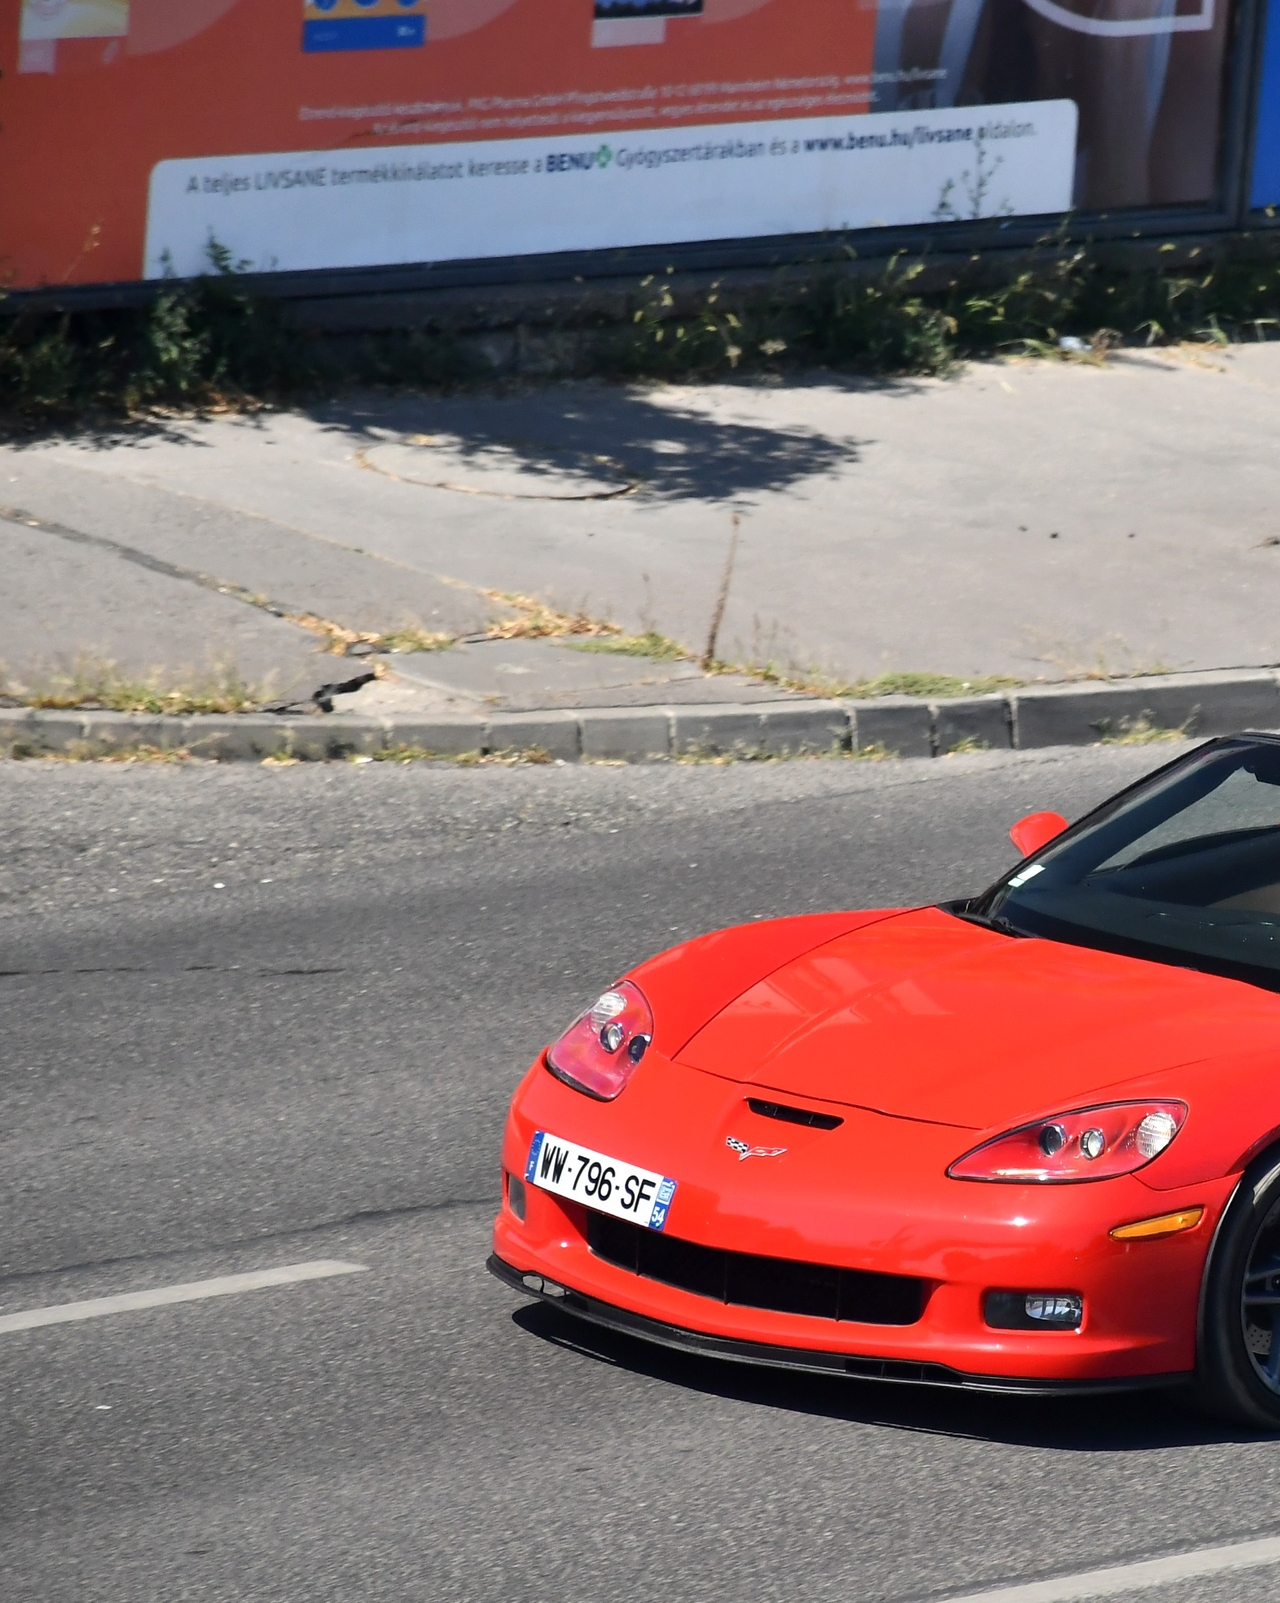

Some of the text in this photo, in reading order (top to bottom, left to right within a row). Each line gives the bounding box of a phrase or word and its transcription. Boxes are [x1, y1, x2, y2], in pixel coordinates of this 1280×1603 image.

[185, 176, 198, 193] A
[202, 173, 251, 196] teljes
[254, 167, 328, 191] LIVSANE
[467, 158, 529, 179] keresse
[533, 159, 542, 174] a
[546, 151, 595, 173] BENU
[616, 136, 765, 171] Gyógyszertárakban
[769, 138, 787, 156] és
[791, 140, 799, 154] a
[803, 124, 973, 152] www.benu.hu/livsane
[528, 1160, 535, 1171] F
[651, 1206, 666, 1224] 54
